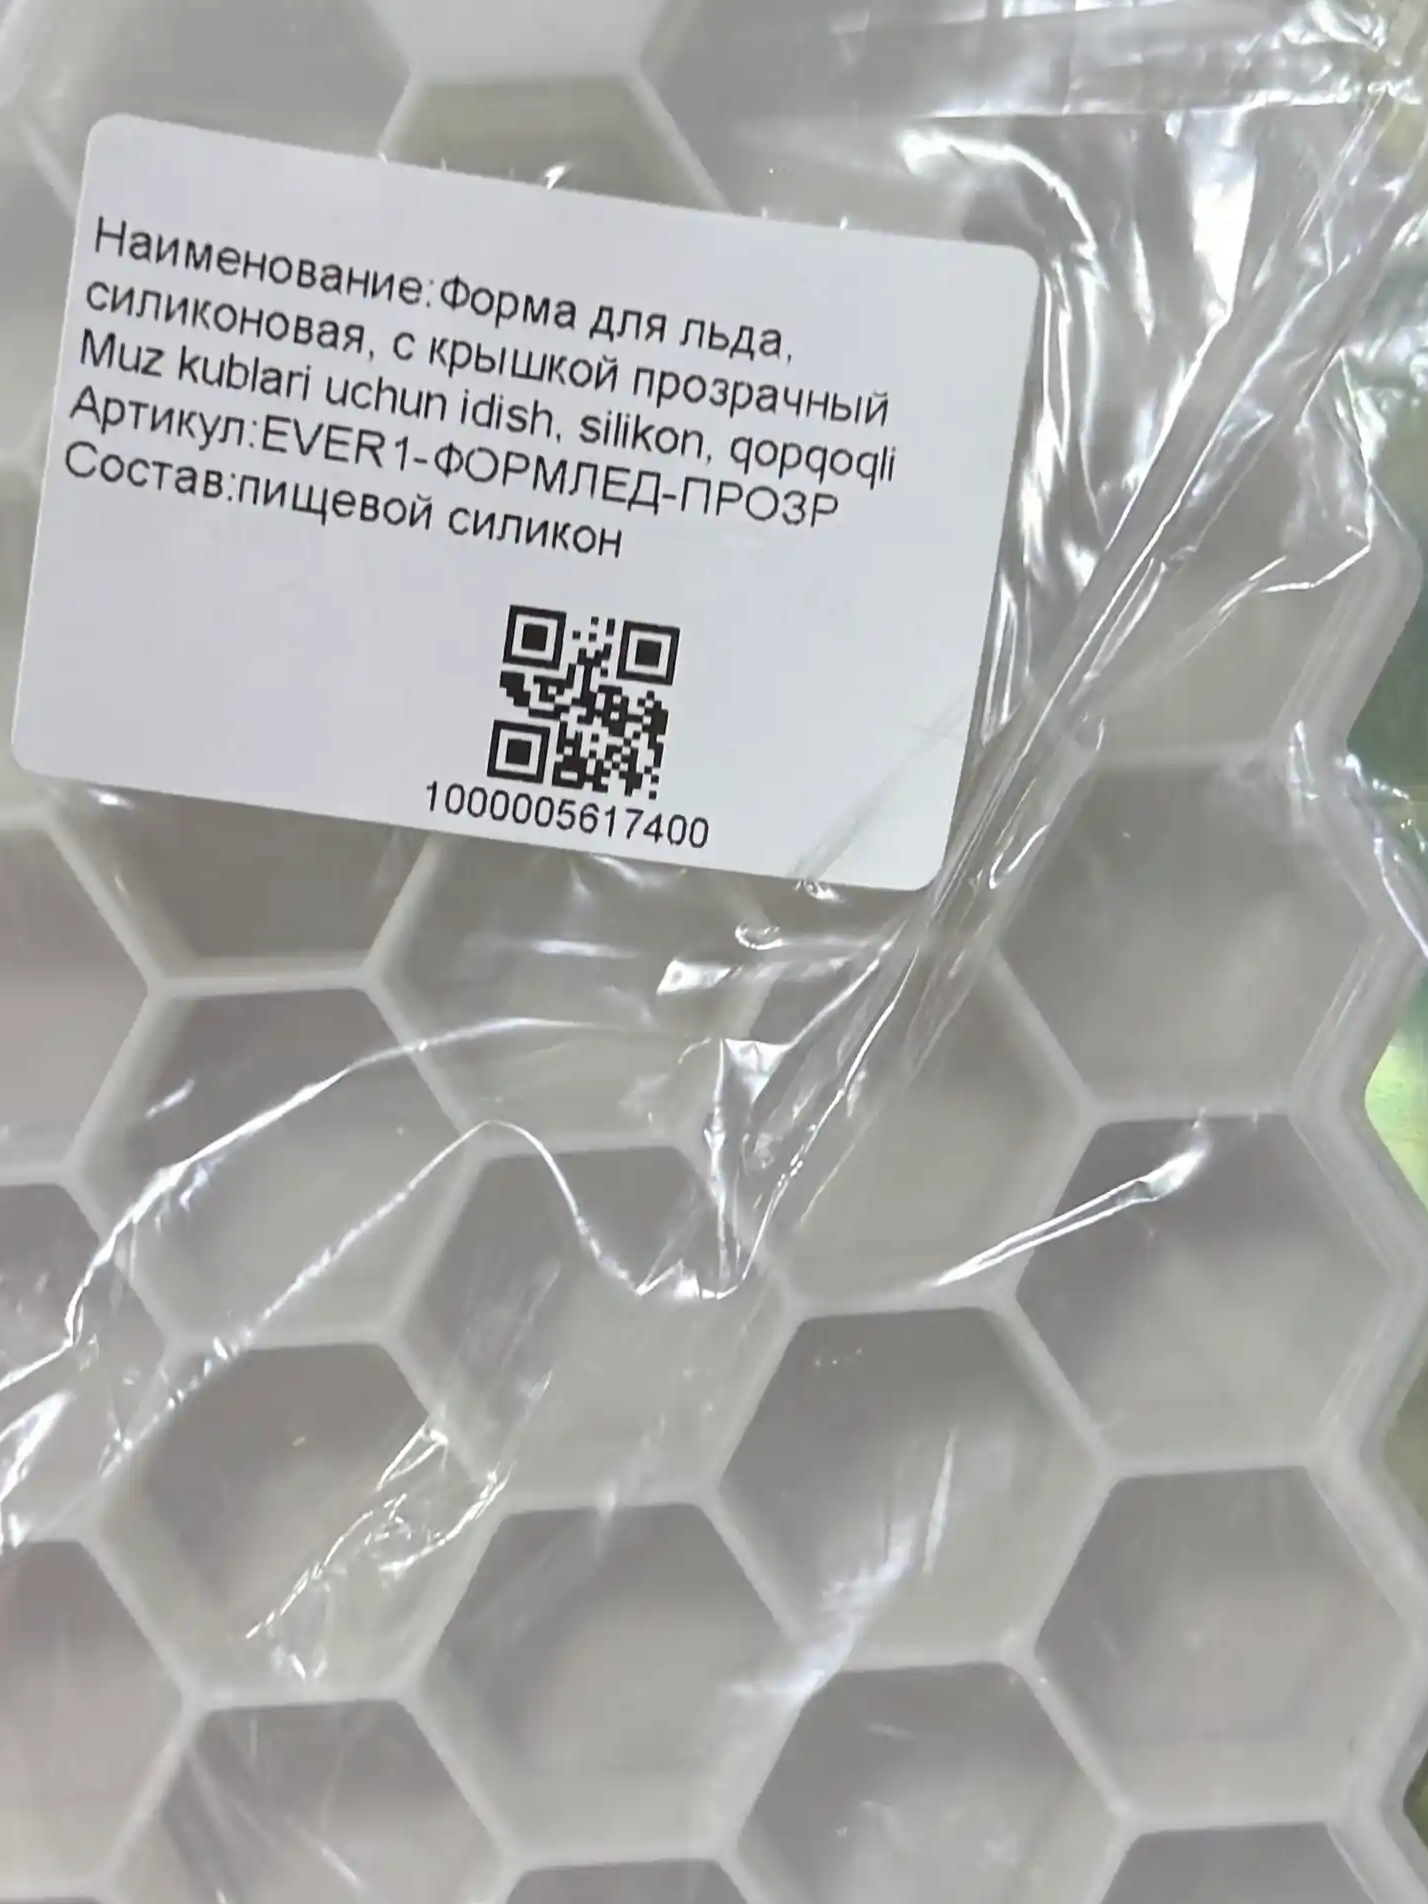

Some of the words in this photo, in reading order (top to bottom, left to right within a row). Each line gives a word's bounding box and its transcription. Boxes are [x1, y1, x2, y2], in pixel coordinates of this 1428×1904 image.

[86, 281, 375, 360] силиконовая,
[392, 331, 416, 361] с
[428, 336, 619, 393] крышкой
[632, 367, 889, 427] прозрачный
[588, 304, 668, 343] для
[679, 318, 793, 364] льда,
[80, 327, 165, 378] Muz
[178, 344, 312, 402] kublari
[325, 375, 447, 422] uchun
[460, 387, 563, 444] idish,
[579, 411, 712, 464] silikon,
[730, 436, 897, 491] qopqoqli
[448, 506, 623, 559] силикон
[425, 780, 710, 849] 1000005617400
